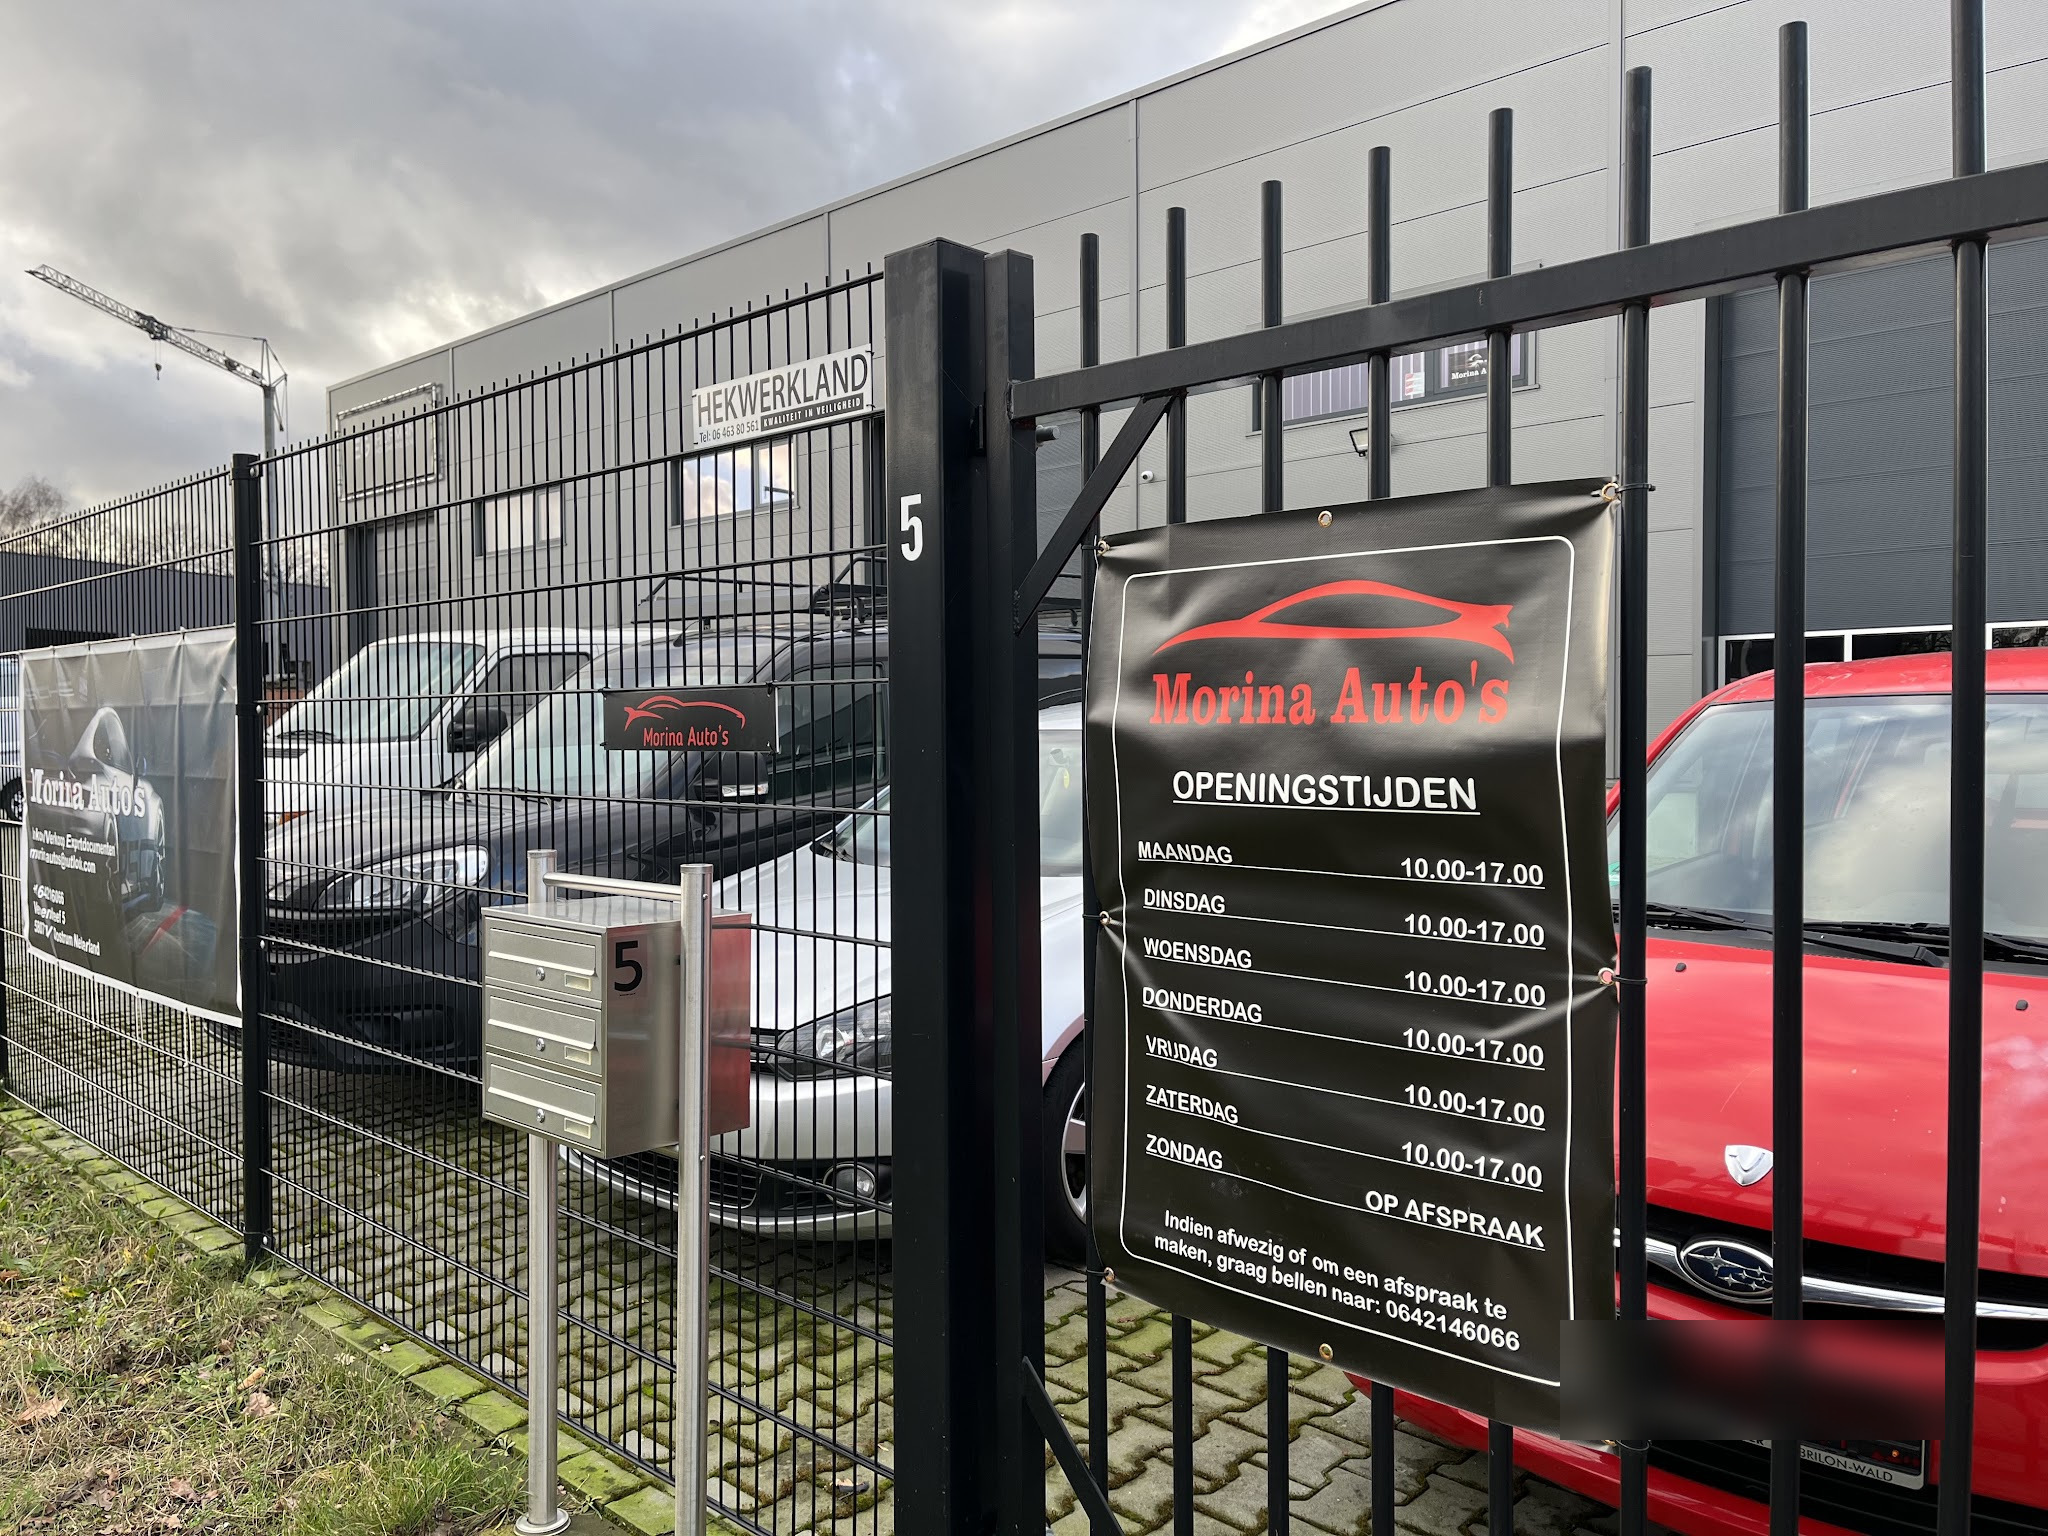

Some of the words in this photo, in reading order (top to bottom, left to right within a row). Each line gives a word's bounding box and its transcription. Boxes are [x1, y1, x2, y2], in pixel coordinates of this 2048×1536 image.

[698, 354, 868, 428] HEKWERKLAND
[1451, 368, 1479, 380] Morina
[699, 430, 711, 443] Tel:
[713, 428, 721, 440] 06
[722, 425, 735, 438] 463
[736, 423, 745, 435] 80
[746, 420, 759, 433] 561
[763, 411, 801, 427] KWALITEIT
[805, 408, 813, 418] IN
[816, 397, 861, 416] VEILIGHEID
[901, 494, 923, 561] 5
[1149, 671, 1316, 726] Morina
[1330, 660, 1510, 725] Auto's
[643, 727, 684, 747] Morina
[688, 724, 729, 746] Auto's
[1172, 770, 1477, 811] OPENINGSTIJDEN
[1138, 840, 1233, 863] MAANDAG
[1401, 857, 1544, 886] 10.00-17.00
[1144, 888, 1225, 914] DINSDAG
[1404, 913, 1545, 946] 10.00-17.00
[614, 940, 643, 992] 5
[1143, 936, 1252, 969] WOENSDAG
[1404, 970, 1546, 1006] 10.00-17.00
[1142, 986, 1262, 1023] DONDERDAG
[1403, 1027, 1544, 1067] 10.00-17.00
[1145, 1034, 1218, 1068] VRIJDAG
[1404, 1084, 1545, 1126] 10.00-17.00
[1145, 1084, 1239, 1124] ZATERDAG
[1401, 1141, 1542, 1188] 10.00-17.00
[1145, 1133, 1223, 1170] ZONDAG
[1365, 1190, 1399, 1213] OP
[1404, 1199, 1544, 1247] AFSPRAAK
[1154, 1235, 1212, 1267] maken,
[1216, 1254, 1267, 1284] graag
[1271, 1265, 1327, 1298] bellen
[1331, 1286, 1381, 1314] naar:
[1385, 1299, 1521, 1351] 0642146066
[1164, 1209, 1214, 1240] Indien
[1217, 1228, 1284, 1263] afwezig
[1288, 1248, 1307, 1266] of
[1312, 1255, 1339, 1277] om
[1343, 1266, 1379, 1288] een
[1384, 1276, 1479, 1314] afspraak
[1484, 1297, 1508, 1320] te
